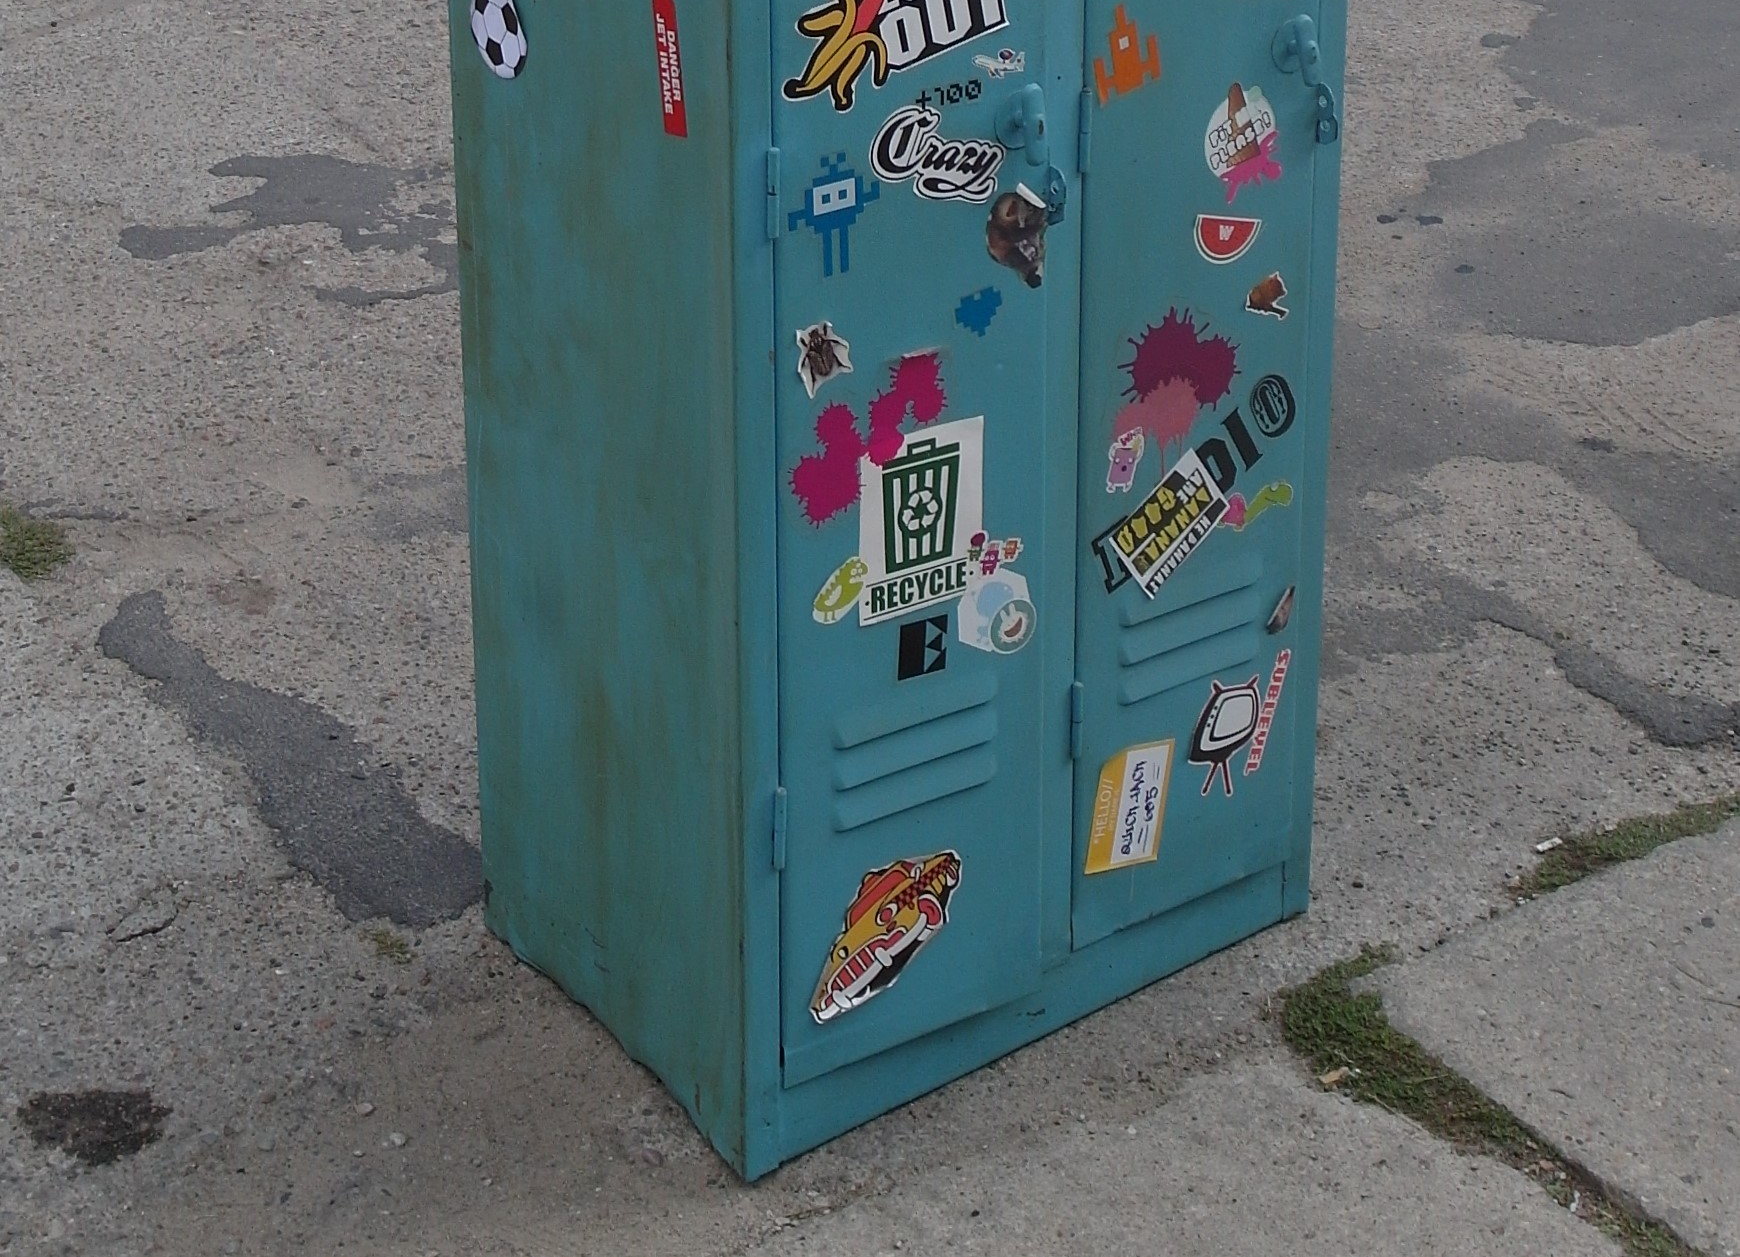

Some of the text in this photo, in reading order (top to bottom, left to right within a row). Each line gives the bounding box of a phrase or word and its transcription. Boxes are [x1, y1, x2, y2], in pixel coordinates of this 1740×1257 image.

[656, 13, 673, 114] JET INTAKE
[667, 30, 681, 101] DANGER
[874, 110, 1003, 197] Crazy
[871, 562, 967, 614] RECYCLE
